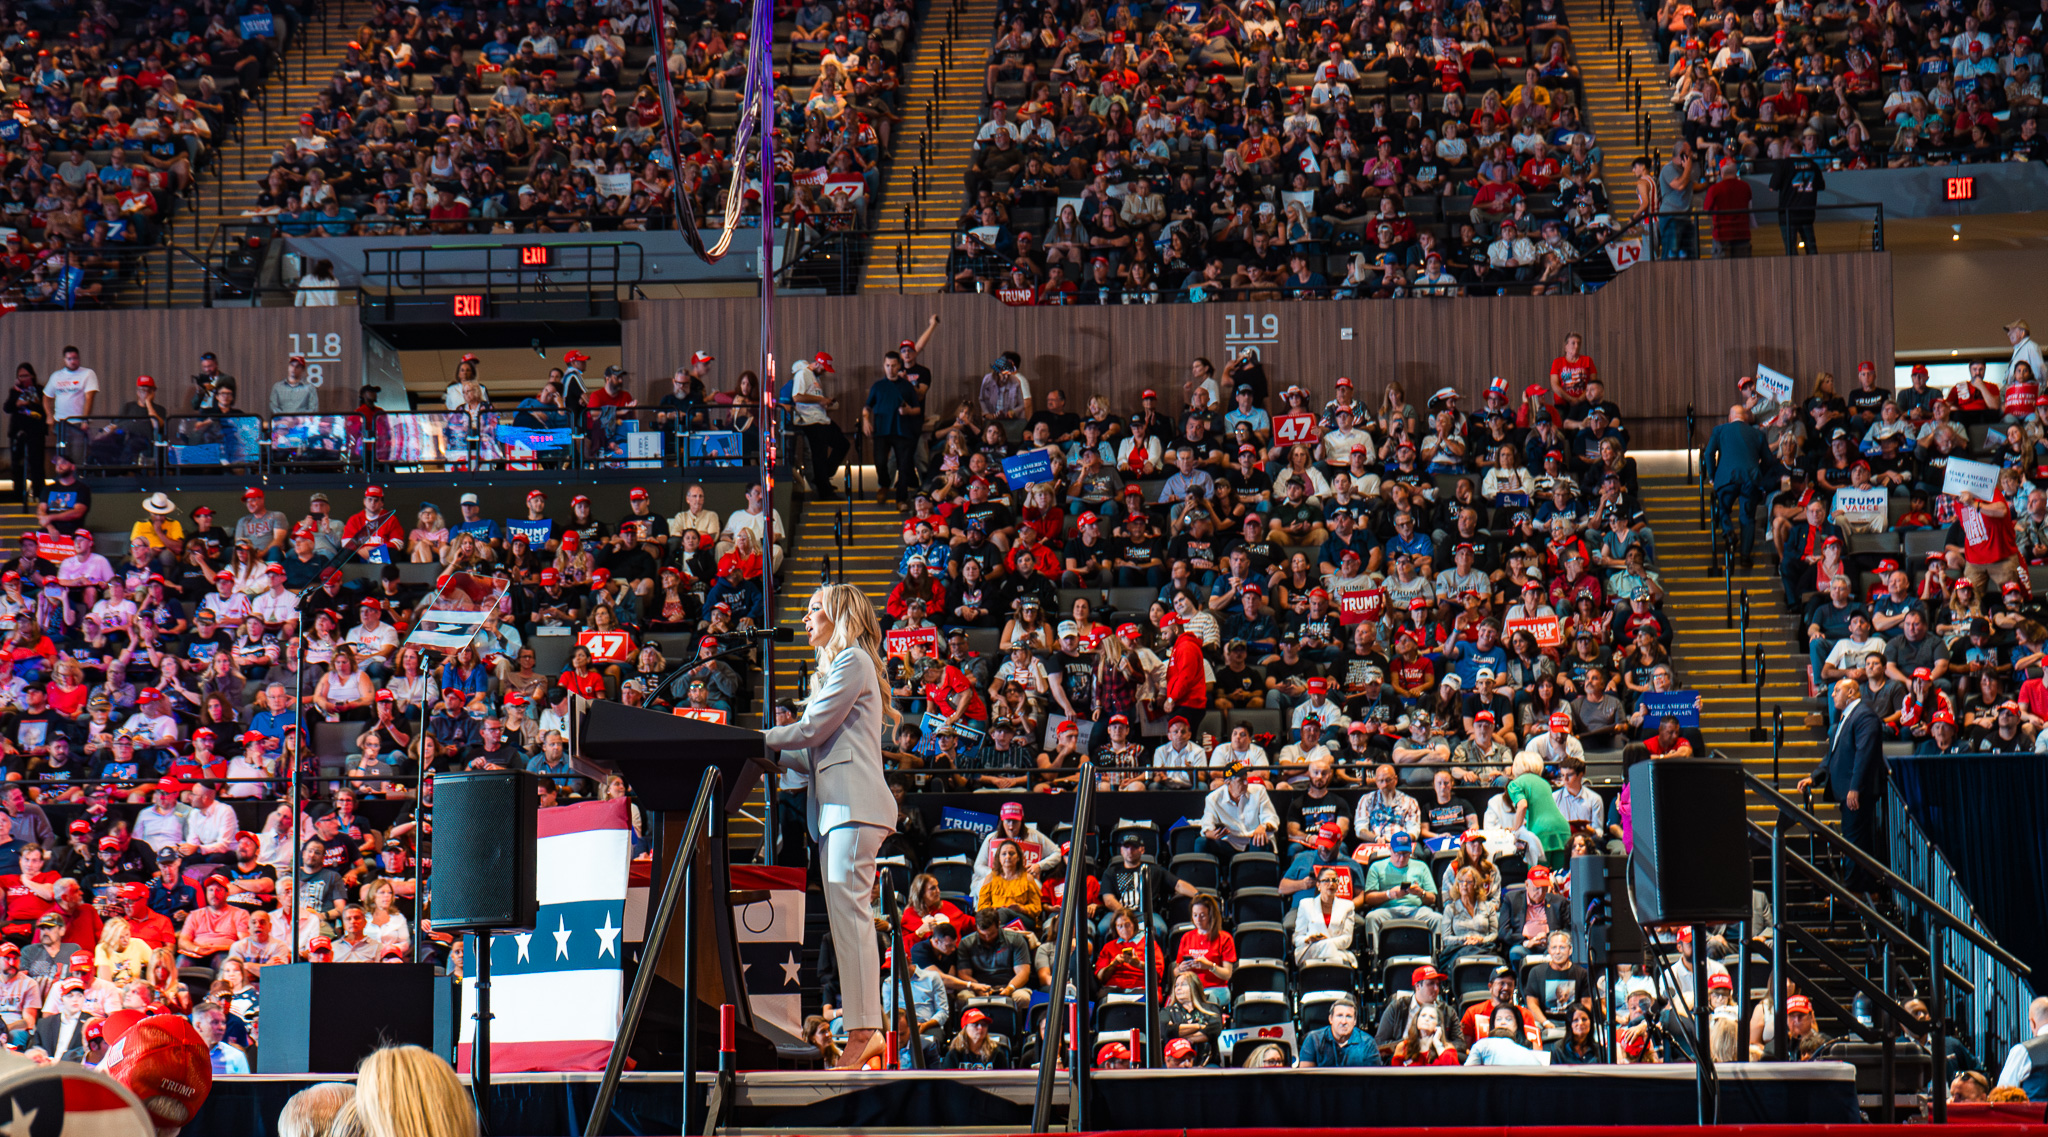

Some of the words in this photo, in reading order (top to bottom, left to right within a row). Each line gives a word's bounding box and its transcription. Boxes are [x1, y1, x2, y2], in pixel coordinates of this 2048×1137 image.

[1947, 177, 1973, 200] EXIT
[522, 247, 548, 264] EXIT
[1617, 245, 1640, 266] 47
[999, 290, 1031, 302] TRUMP
[454, 295, 483, 316] EXIT
[1224, 313, 1279, 339] 119
[288, 333, 342, 360] 118
[306, 363, 325, 388] 8
[1760, 373, 1790, 393] TRUMP
[1762, 381, 1785, 398] VANCE
[1277, 418, 1312, 441] 47
[1006, 465, 1023, 475] MAKE
[1022, 461, 1048, 471] AMERICA
[1010, 470, 1029, 480] GREAT
[1028, 467, 1046, 477] AGAIN
[1949, 469, 1965, 480] MAKE
[1967, 472, 1993, 484] AMERICA
[1950, 477, 1970, 487] GREAT
[1970, 481, 1989, 489] AGAIN
[1840, 496, 1884, 506] TRUMP
[1845, 504, 1880, 512] VANCE
[246, 522, 270, 535] USA
[509, 526, 550, 539] TRUMP
[1342, 595, 1380, 612] TRUMP
[1510, 622, 1556, 635] TRUMP
[585, 635, 625, 658] 47
[889, 635, 935, 648] TRUP
[1647, 703, 1669, 711] MAKE
[1670, 703, 1696, 711] AMERICA
[944, 816, 993, 832] TRUMP
[990, 847, 1039, 860] TMP
[159, 1076, 197, 1099] TRUMP
